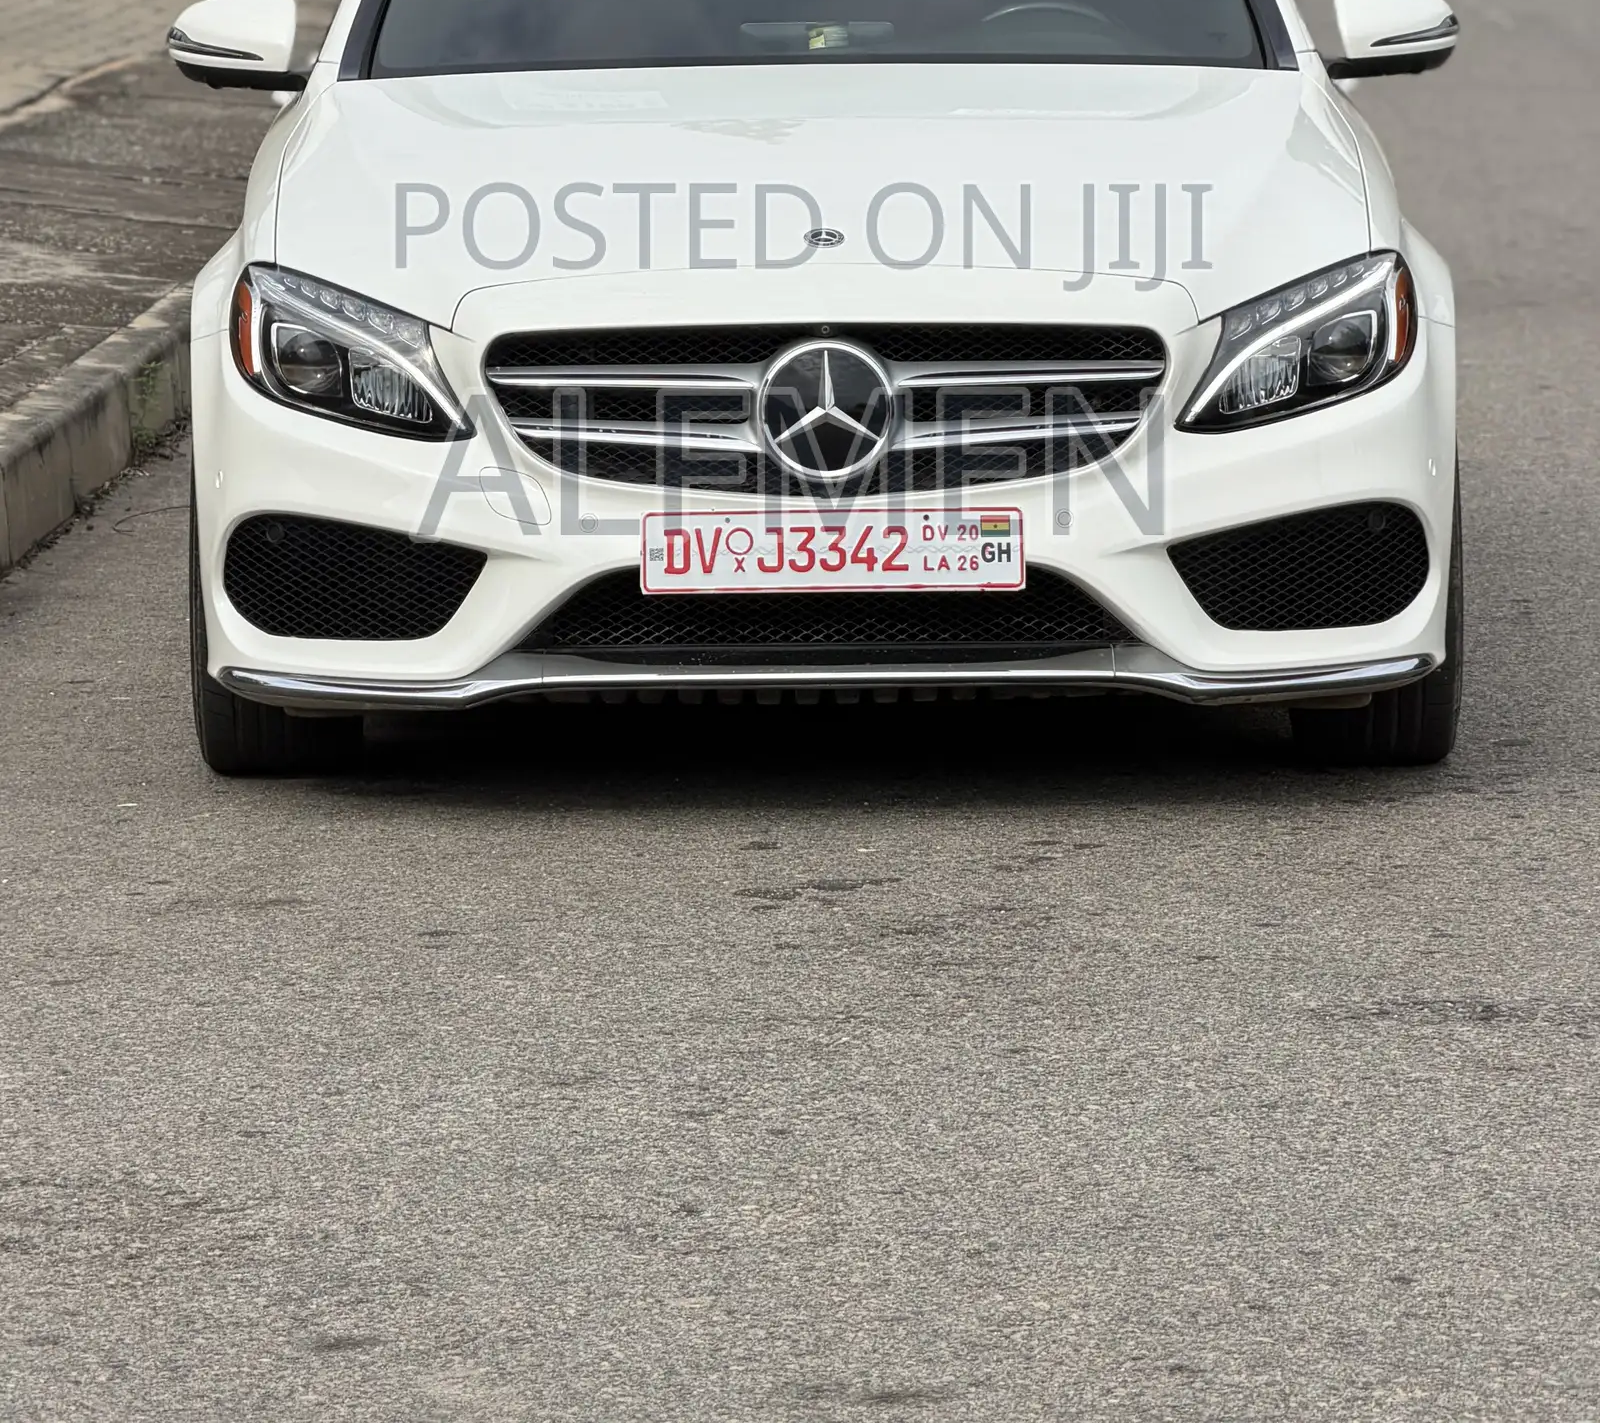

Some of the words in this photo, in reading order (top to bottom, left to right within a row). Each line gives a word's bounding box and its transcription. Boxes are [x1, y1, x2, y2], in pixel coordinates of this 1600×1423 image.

[922, 524, 949, 541] DV
[957, 524, 979, 541] 20
[664, 527, 722, 574] DV
[757, 526, 909, 573] J3342
[981, 542, 1012, 563] GH
[923, 555, 950, 571] LA
[957, 555, 979, 571] 26
